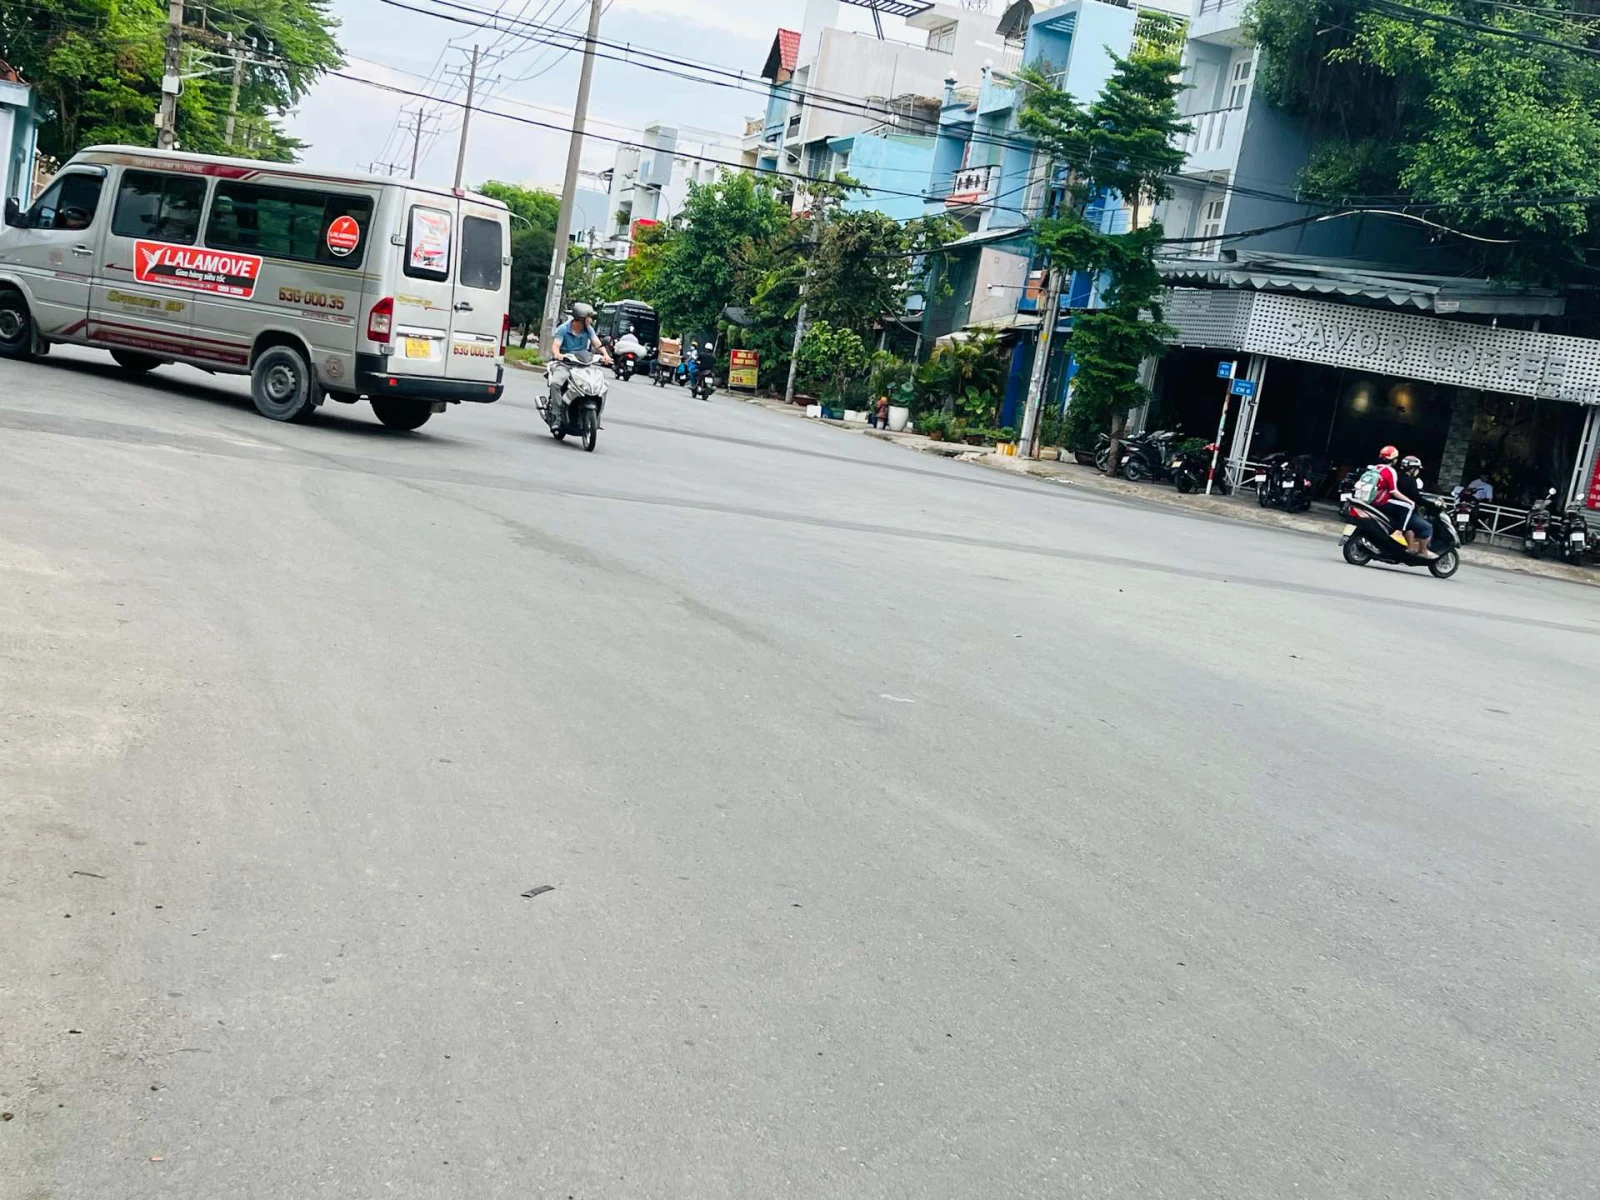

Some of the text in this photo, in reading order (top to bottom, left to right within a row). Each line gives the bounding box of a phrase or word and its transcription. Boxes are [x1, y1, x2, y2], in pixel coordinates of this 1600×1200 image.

[163, 249, 253, 277] LALAMOVE
[1281, 318, 1567, 385] SAVOR COFFEE
